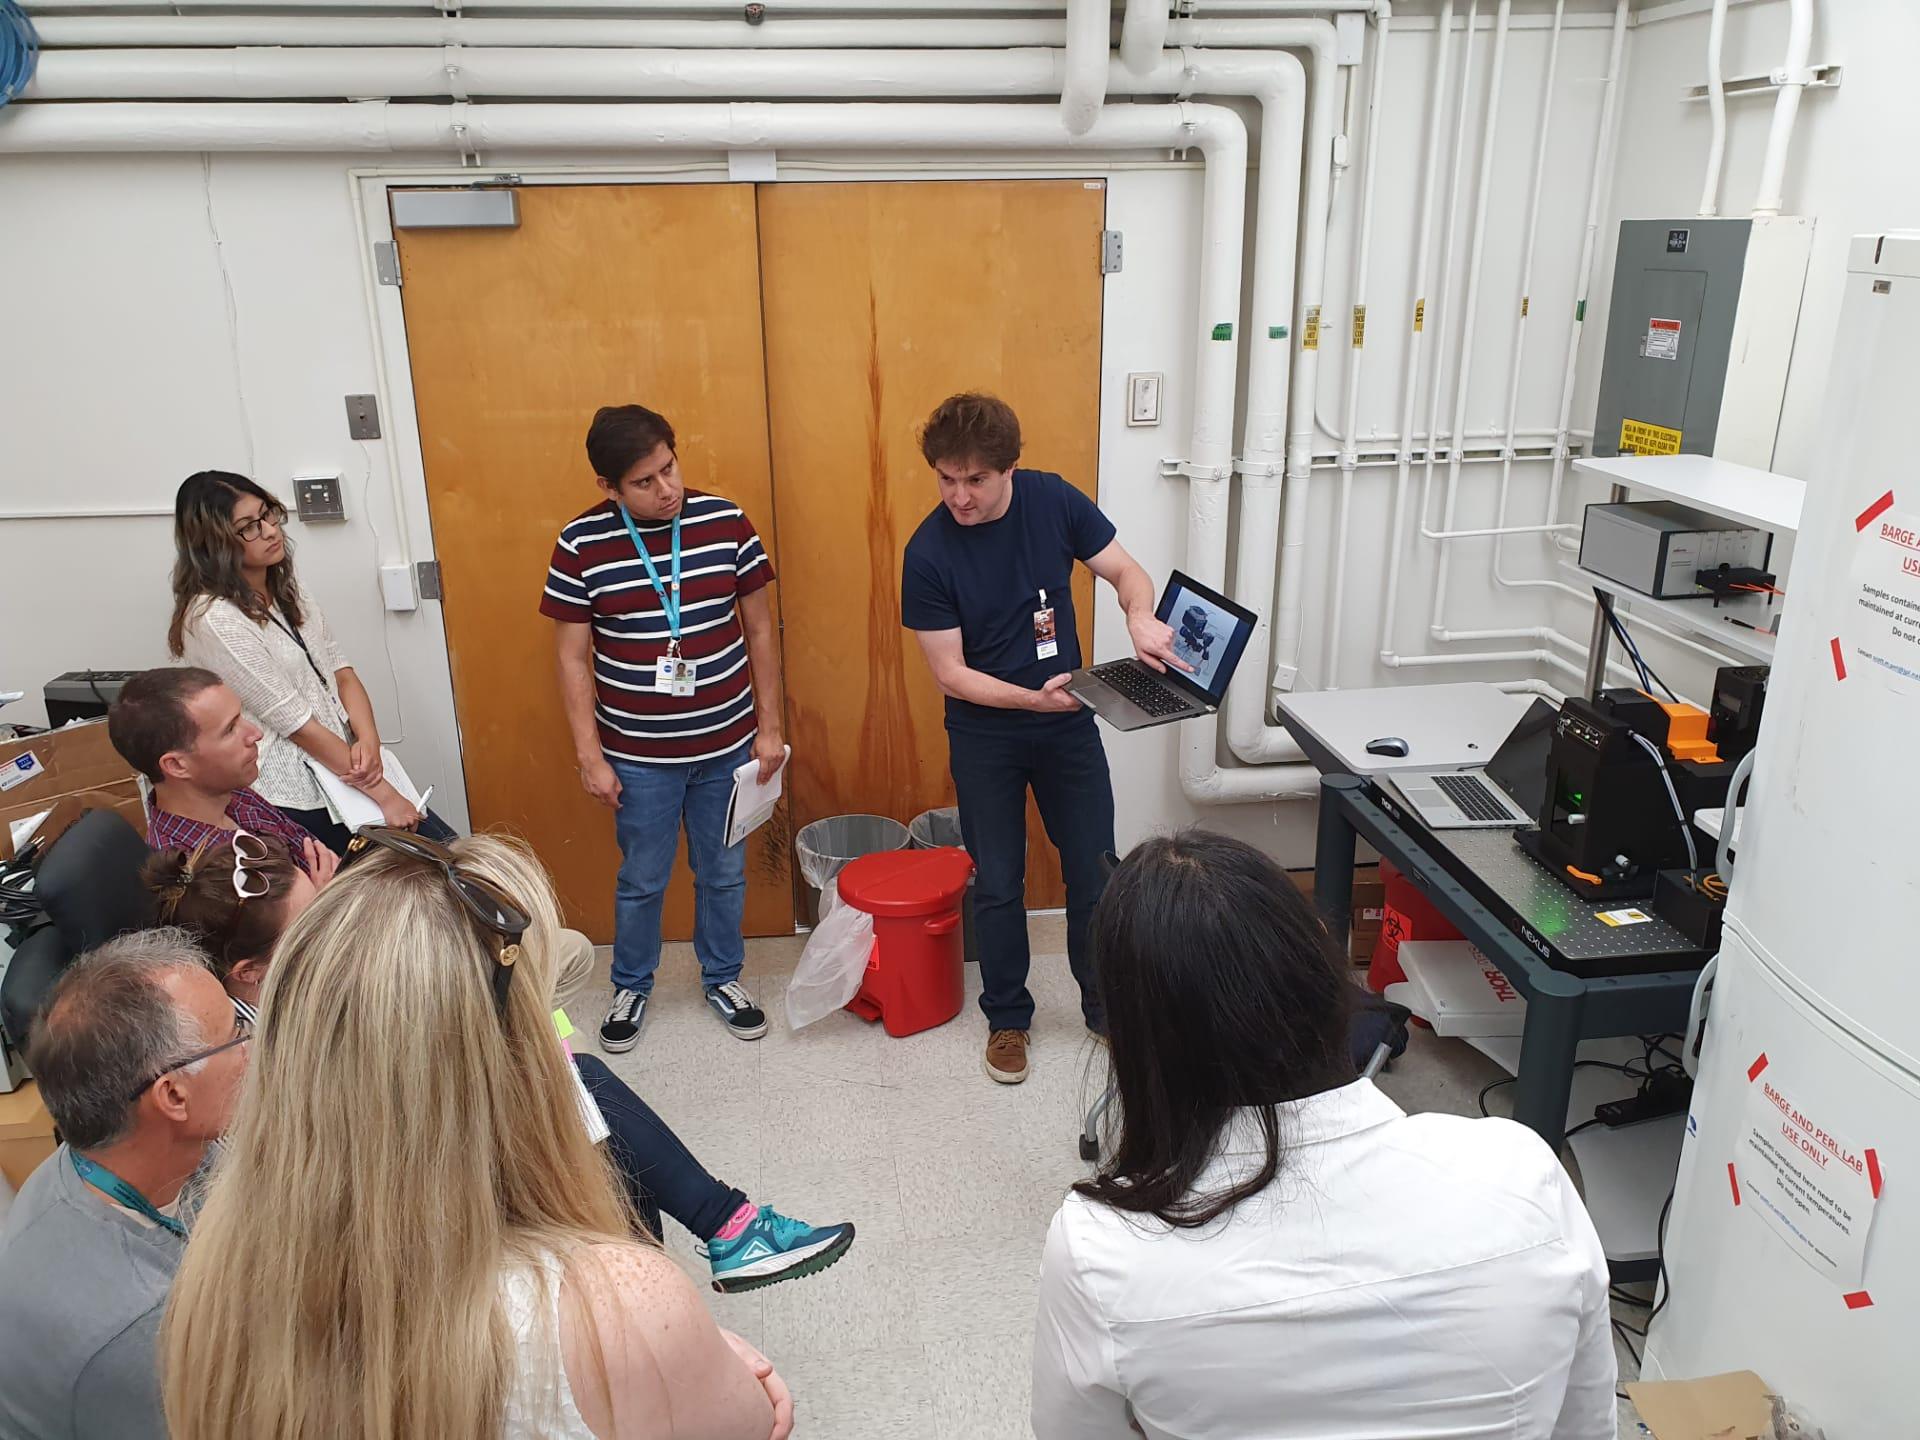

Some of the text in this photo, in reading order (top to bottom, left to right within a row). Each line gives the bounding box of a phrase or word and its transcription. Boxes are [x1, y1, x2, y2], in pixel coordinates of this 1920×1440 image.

[1881, 523, 1916, 545] BARGE
[1863, 583, 1890, 600] Samples
[1859, 598, 1895, 618] maintained
[1895, 613, 1903, 621] at
[1892, 626, 1902, 637] Do
[1904, 632, 1916, 643] not
[1521, 925, 1550, 958] NEXUS
[1763, 1082, 1863, 1172] BARGE AND PERL LAB
[1782, 1121, 1829, 1167] USE ONLY
[1749, 1138, 1778, 1169] maintained
[1779, 1167, 1785, 1176] at
[1785, 1174, 1805, 1196] current
[1753, 1128, 1852, 1221] Samples contained here need to be
[1776, 1177, 1785, 1189] Do
[1785, 1187, 1794, 1199] not
